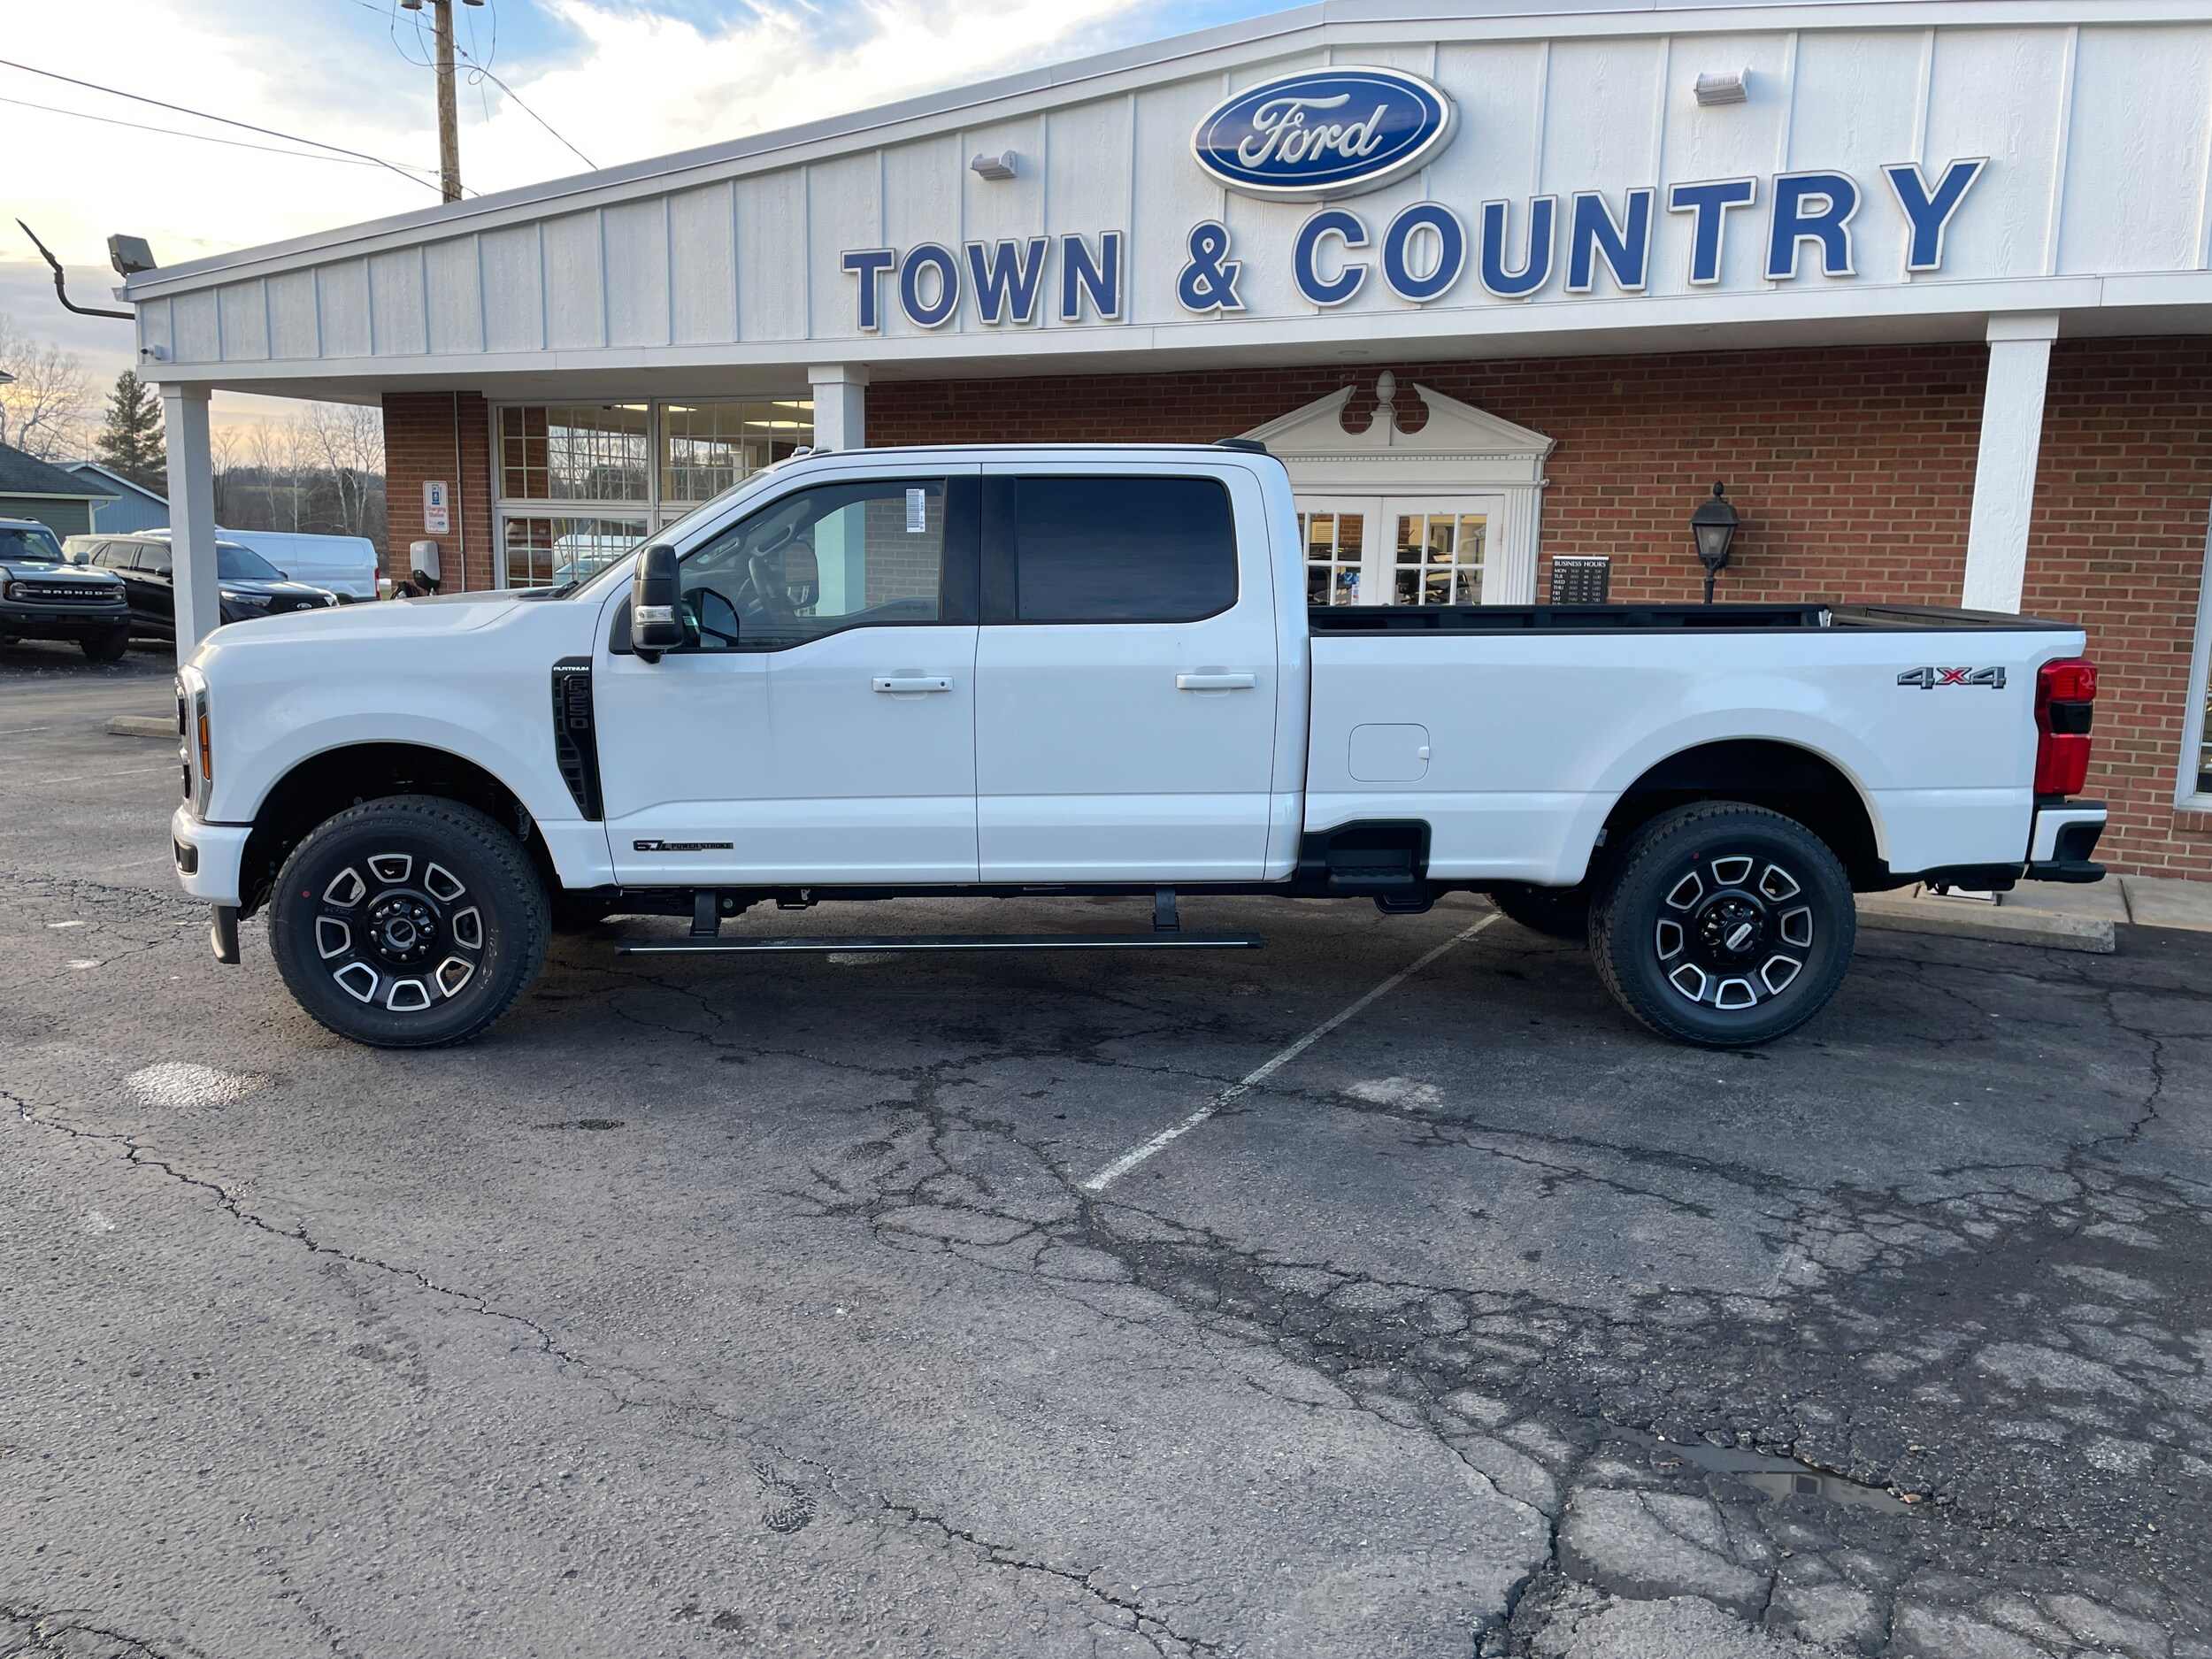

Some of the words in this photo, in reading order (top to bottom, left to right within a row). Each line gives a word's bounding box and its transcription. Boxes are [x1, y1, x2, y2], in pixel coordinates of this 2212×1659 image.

[1237, 92, 1389, 167] Ford
[841, 230, 1122, 331] TOWN
[1175, 219, 1248, 314] &
[1291, 156, 1990, 308] COUNTRY
